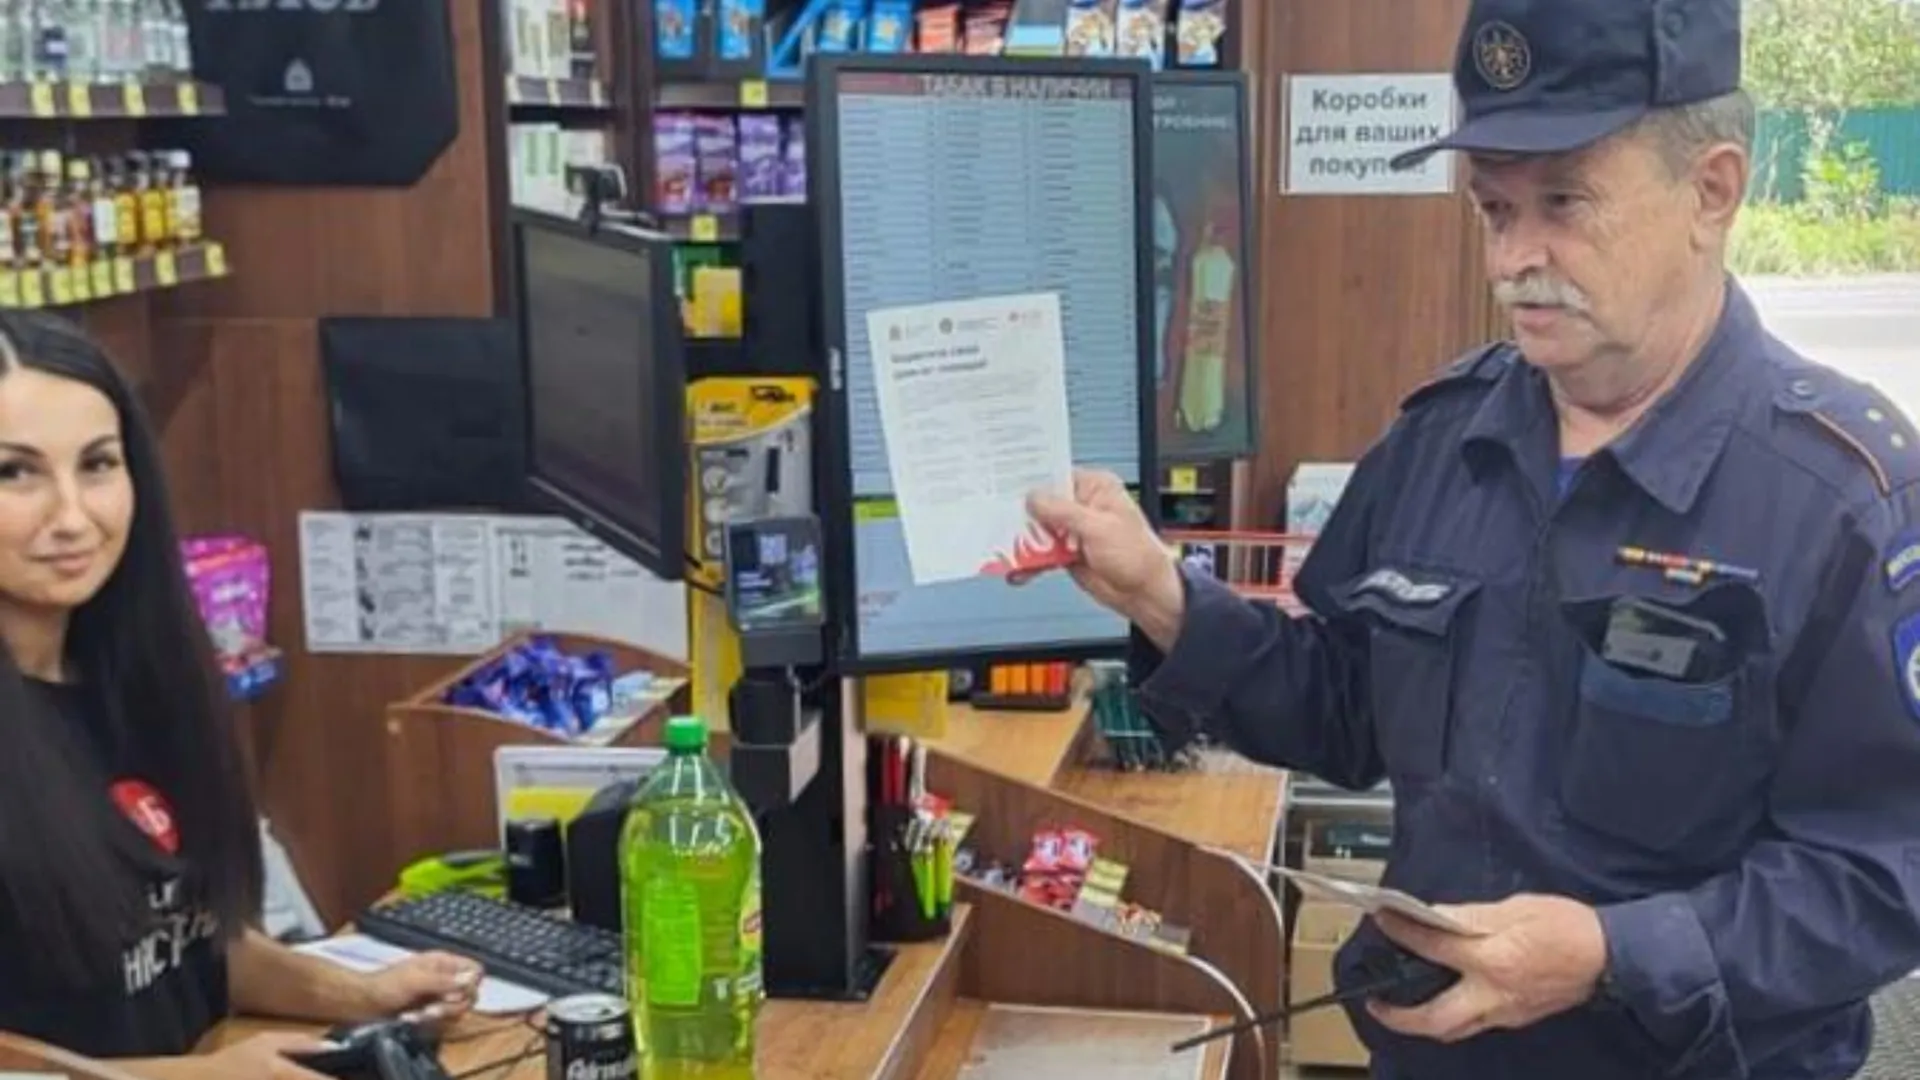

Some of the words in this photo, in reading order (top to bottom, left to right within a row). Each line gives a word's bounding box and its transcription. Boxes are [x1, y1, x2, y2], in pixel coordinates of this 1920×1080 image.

[1312, 86, 1427, 113] Коробки
[1296, 124, 1345, 145] для
[1355, 124, 1439, 142] ваших
[1310, 156, 1427, 180] покуп
